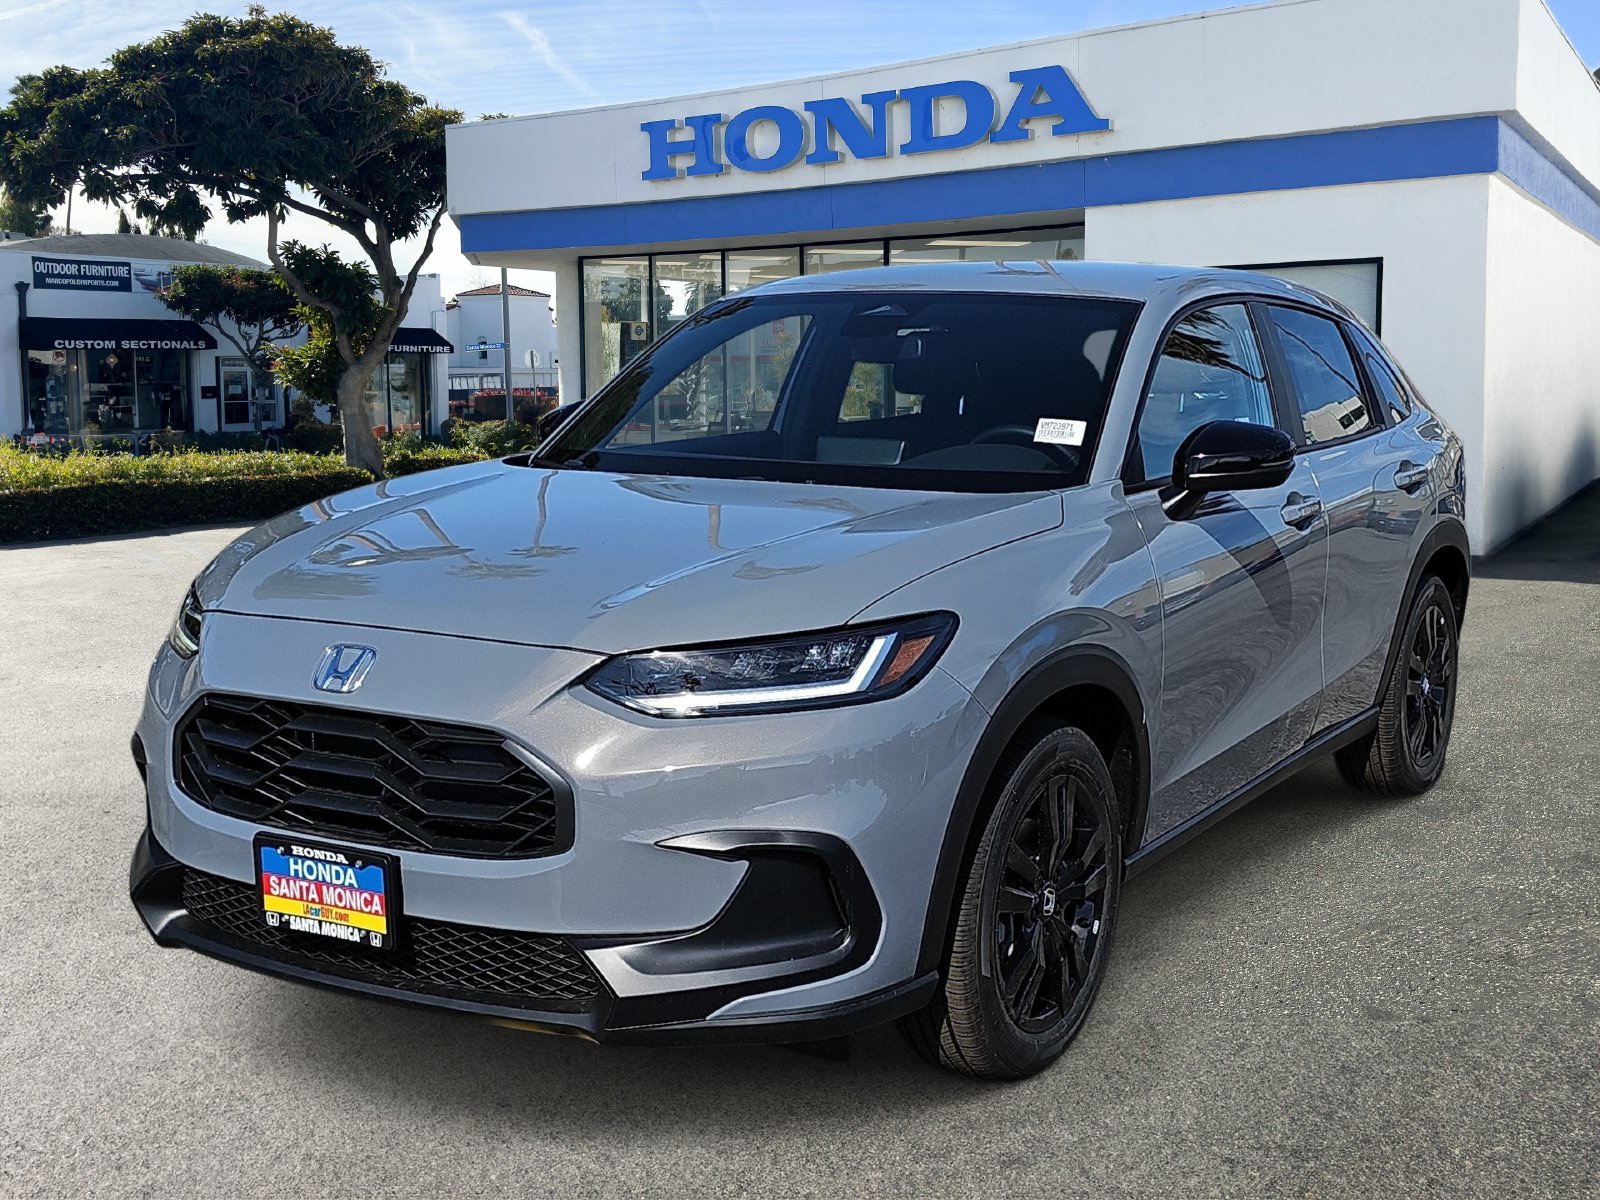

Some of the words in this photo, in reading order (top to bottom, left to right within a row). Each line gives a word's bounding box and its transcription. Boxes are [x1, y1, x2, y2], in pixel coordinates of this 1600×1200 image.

[640, 64, 1110, 181] HONDA
[34, 261, 79, 275] OUTDOOR
[80, 264, 130, 278] FURNITURE
[45, 277, 120, 287] MARCOPOLOIMPORTS.COM
[54, 339, 116, 349] CUSTOM
[121, 340, 206, 349] SECTIONALS
[388, 344, 451, 353] FURNITURE
[291, 845, 349, 865] HONDA
[289, 857, 358, 888] HONDA
[269, 875, 319, 903] SANTA
[322, 884, 383, 915] MONICA
[290, 915, 321, 935] SANTA
[321, 921, 361, 942] MONICA
